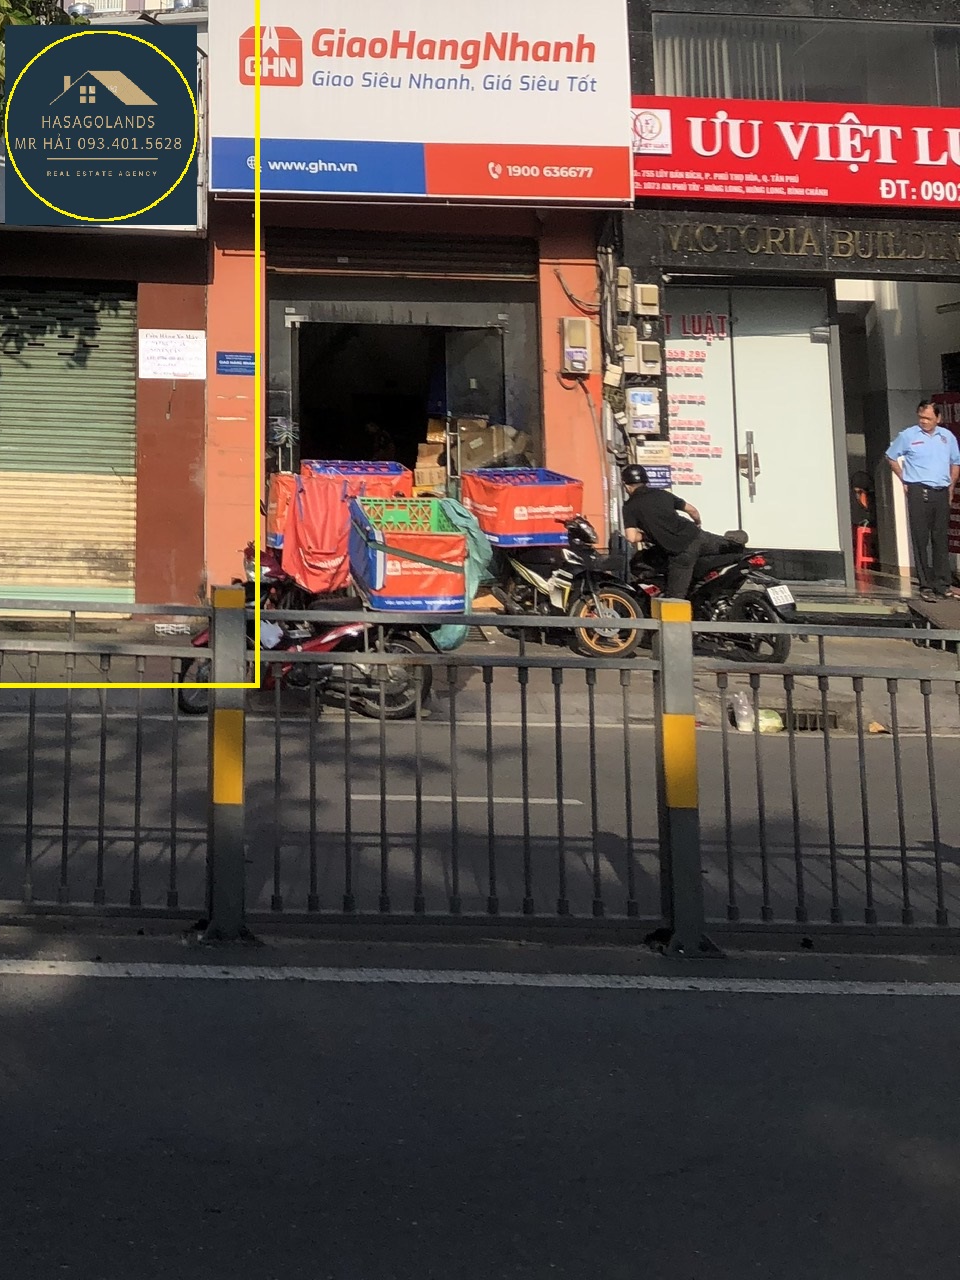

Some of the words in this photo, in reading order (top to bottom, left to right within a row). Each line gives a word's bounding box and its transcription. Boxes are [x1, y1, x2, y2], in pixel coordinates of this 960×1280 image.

[311, 28, 596, 69] GiaoHangNhanh
[244, 56, 297, 78] GHN
[312, 70, 354, 87] Giao
[361, 71, 402, 88] Siêu
[408, 73, 475, 91] Nhanh,
[482, 73, 512, 91] Giá
[519, 75, 559, 92] Siêu
[567, 74, 597, 93] Tốt
[685, 110, 763, 158] ƯU
[774, 112, 902, 173] VIỆT
[268, 158, 358, 174] www.ghn.vn
[506, 165, 540, 177] 1900
[543, 166, 593, 178] 636677
[879, 178, 917, 200] ĐT:
[920, 180, 960, 202] 090
[661, 223, 823, 258] VICTORIA
[830, 229, 960, 262] BUILDI
[681, 310, 728, 341] LUẬT
